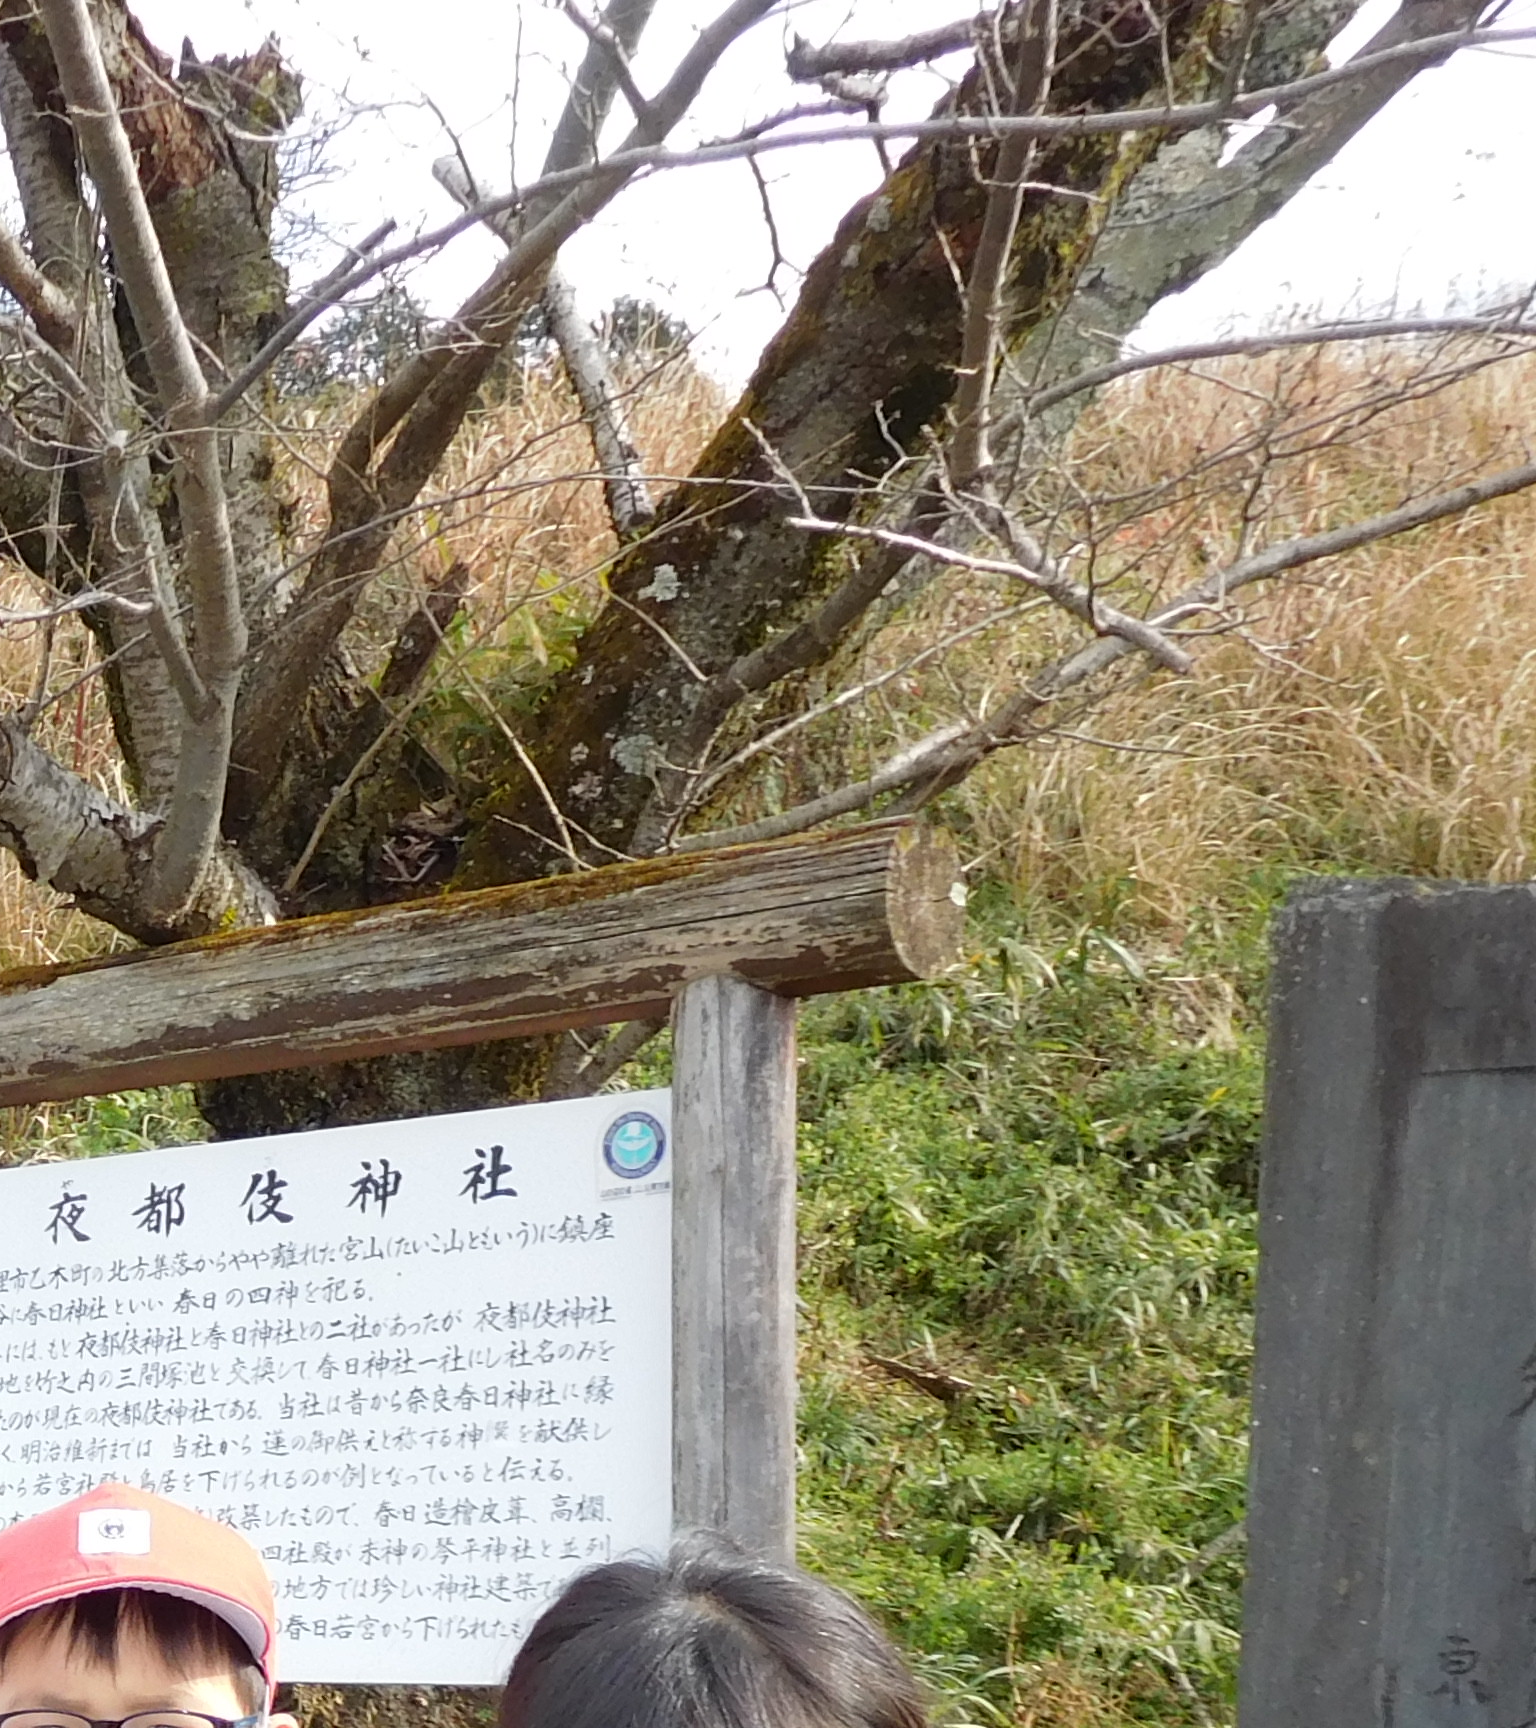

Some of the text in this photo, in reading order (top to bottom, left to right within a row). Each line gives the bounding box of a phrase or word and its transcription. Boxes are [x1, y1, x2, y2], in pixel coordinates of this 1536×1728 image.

[44, 1145, 518, 1244] 夜都伎神社
